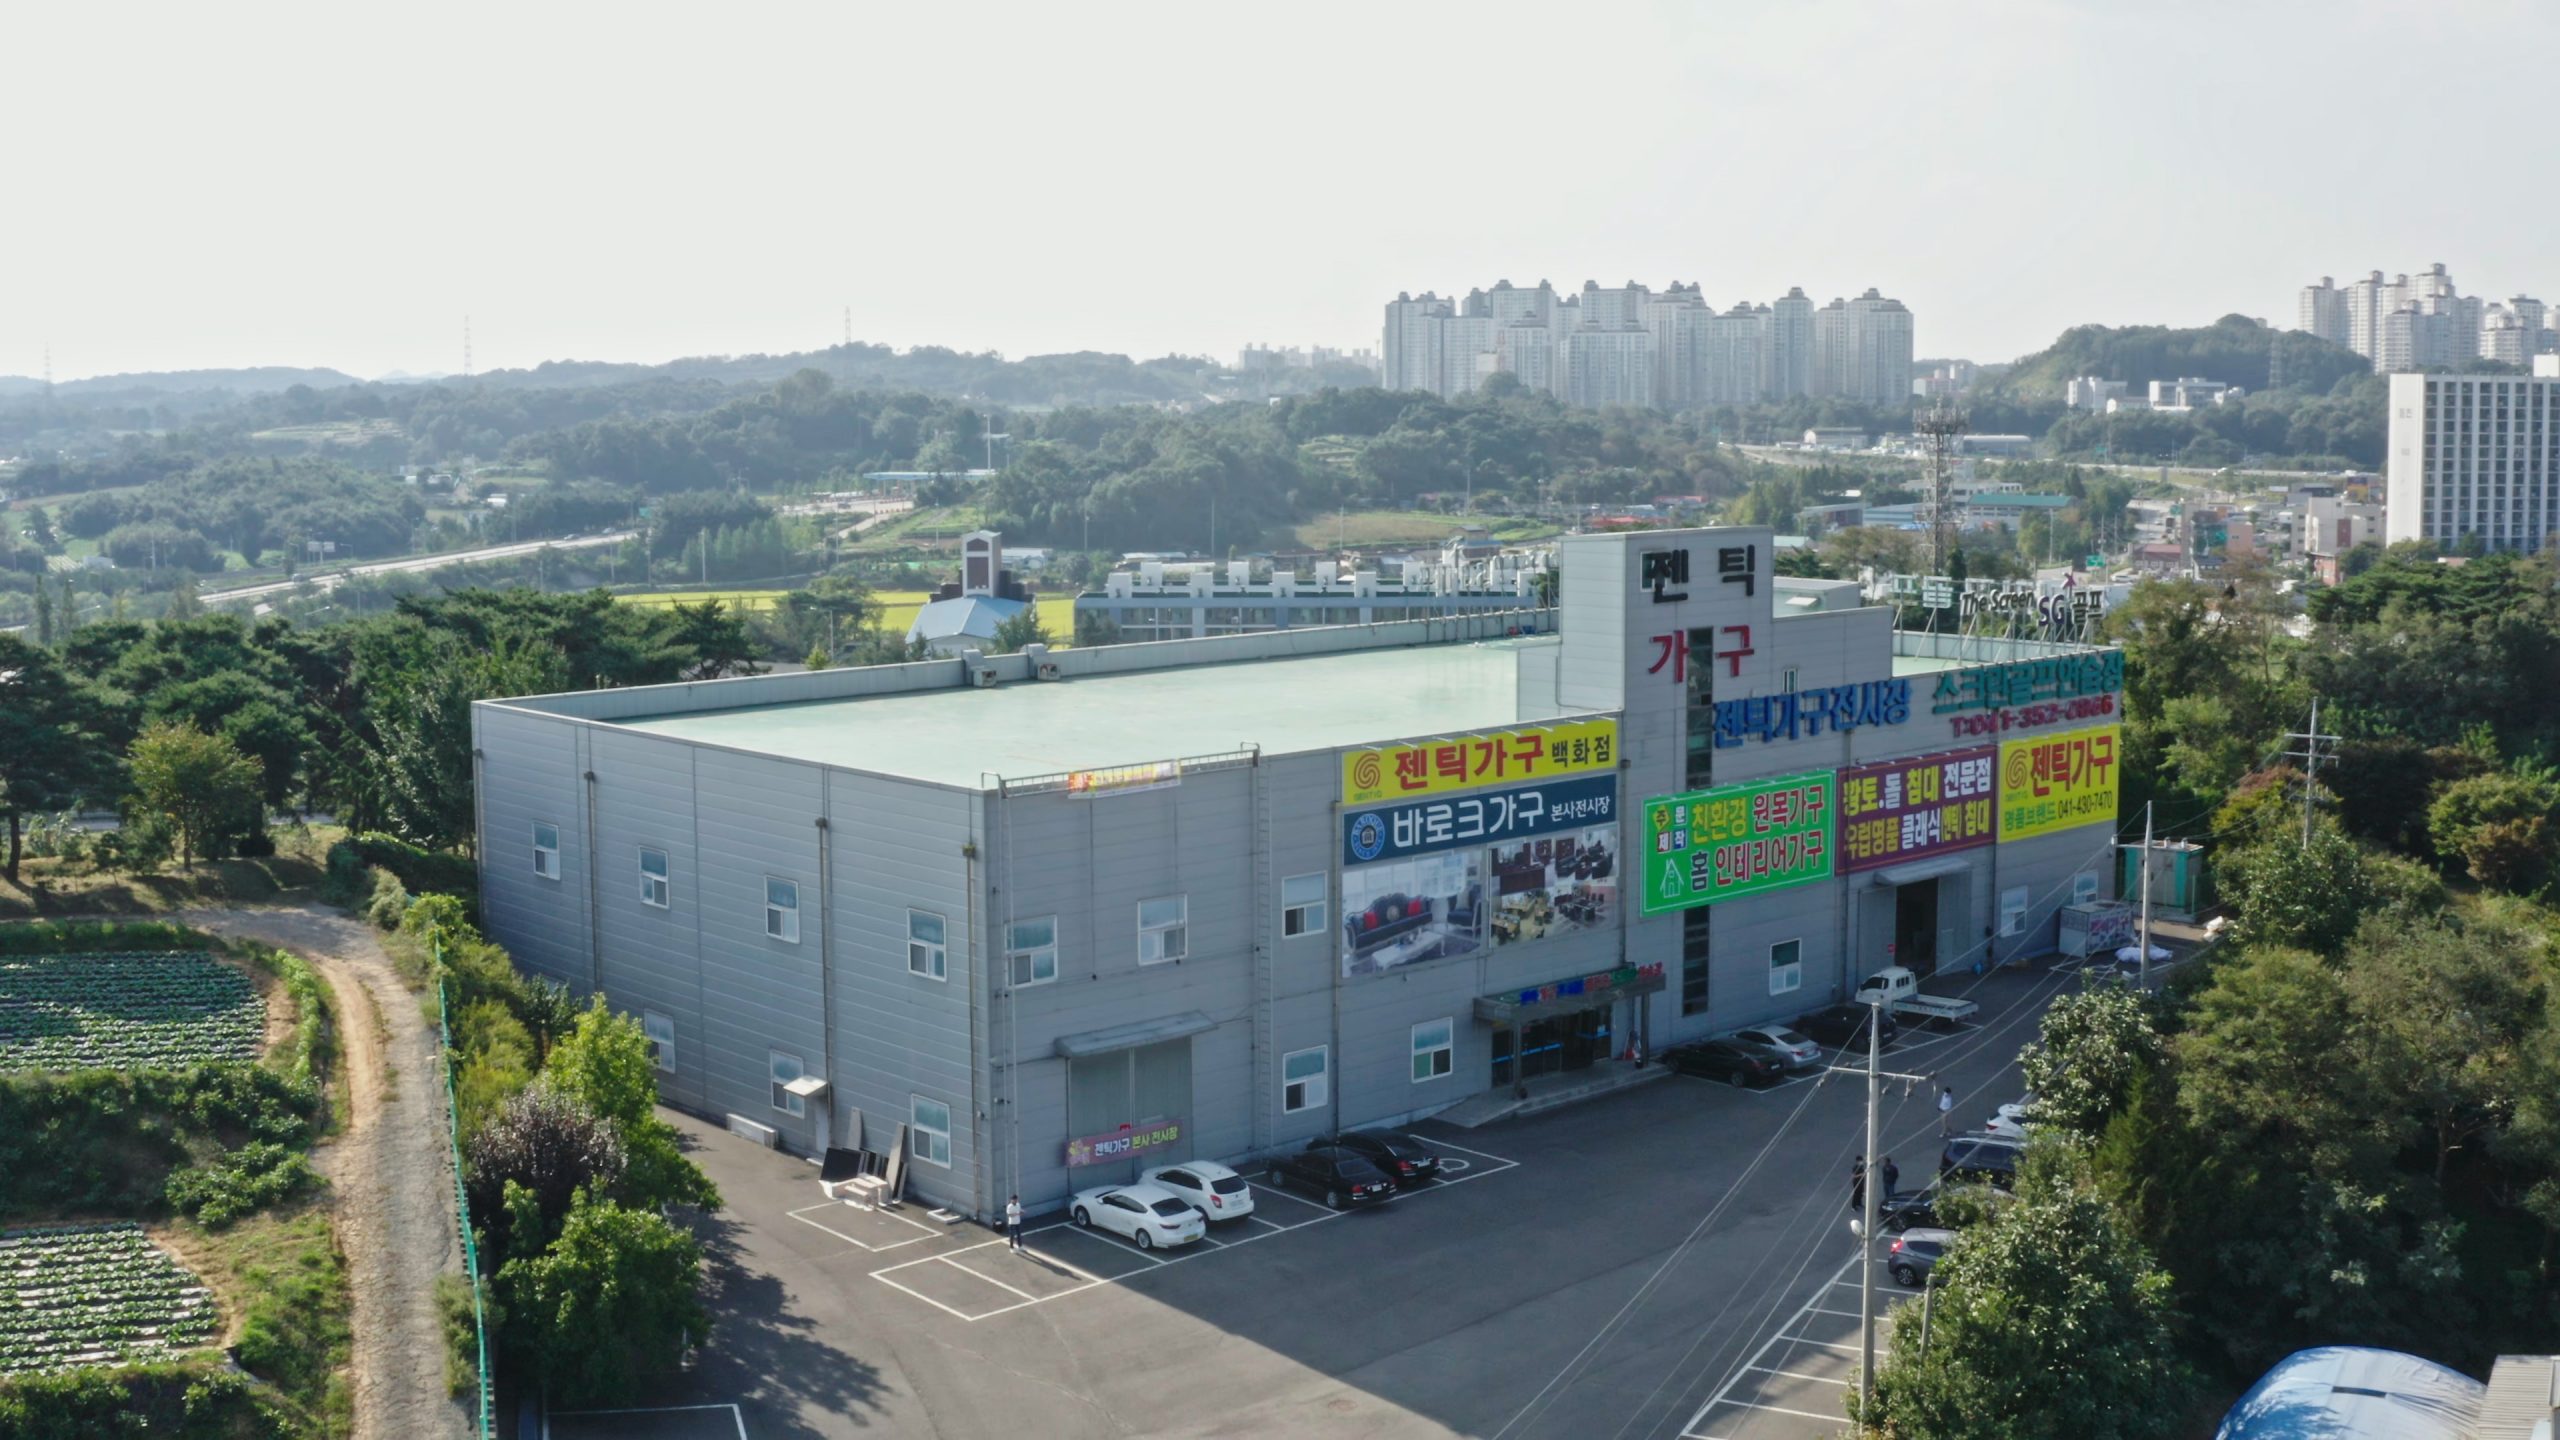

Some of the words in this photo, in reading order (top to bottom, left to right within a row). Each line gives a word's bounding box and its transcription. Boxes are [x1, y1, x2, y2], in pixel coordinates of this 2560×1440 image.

[1648, 544, 1755, 604] 젠틱
[1960, 590, 1988, 617] The
[1990, 588, 2035, 612] Screen
[2037, 594, 2066, 627] SG
[1648, 624, 1755, 683] 가구
[1713, 679, 1911, 749] 젠틱가구전시장
[1394, 735, 1544, 791] 젠틱가구
[1551, 734, 1611, 768] 백화점
[1907, 764, 1940, 806] 침대
[1944, 756, 1992, 799] 전문점
[2031, 735, 2114, 798] 젠틱가구
[1393, 790, 1545, 848] 바로크가구
[1550, 795, 1611, 822] 본사전시장
[1691, 796, 1748, 845] 친환경
[1753, 784, 1825, 833] 원목가구
[1844, 816, 1899, 860] 유럽명품
[1965, 798, 1990, 837] 침대
[1691, 850, 1709, 892] 홈
[1715, 829, 1824, 887] 인테리어가구
[1094, 1137, 1130, 1156] 젠틱가구
[1151, 1126, 1178, 1145] 전시장
